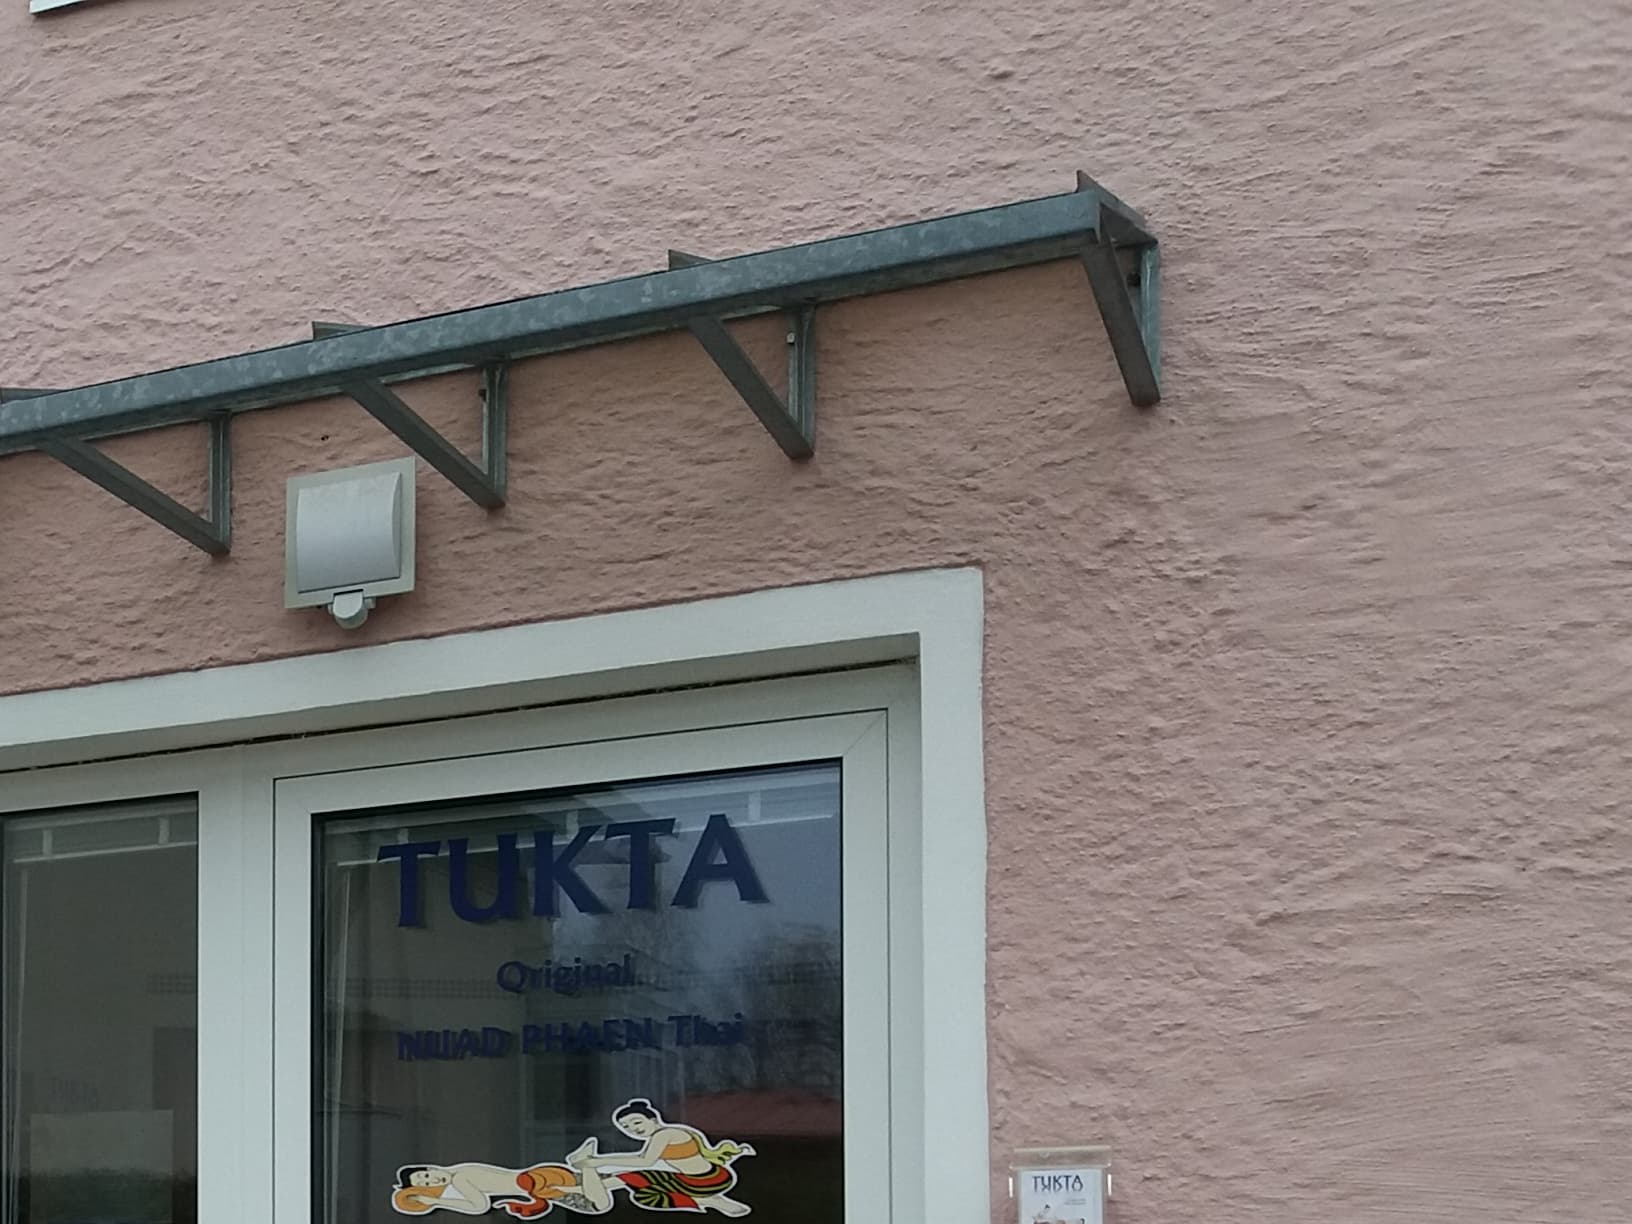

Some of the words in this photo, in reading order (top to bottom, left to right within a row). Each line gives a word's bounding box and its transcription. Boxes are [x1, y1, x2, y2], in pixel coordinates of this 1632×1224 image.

[377, 813, 770, 928] TUKTA
[497, 954, 637, 994] Original
[1032, 1174, 1085, 1194] TUKTA
